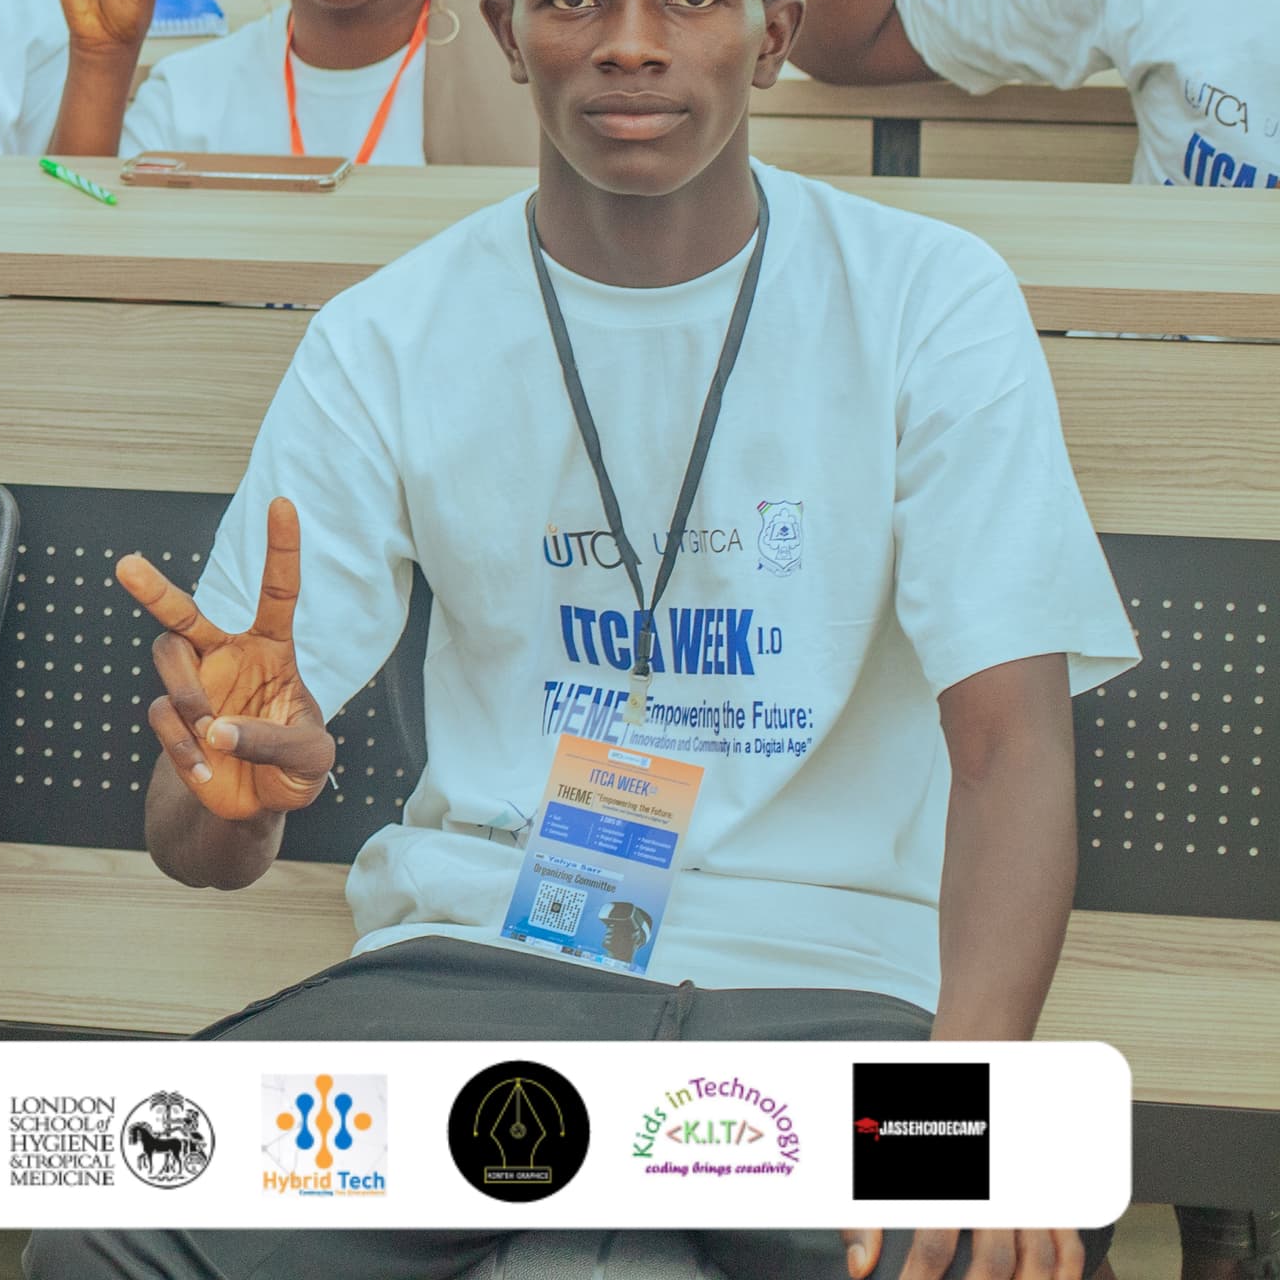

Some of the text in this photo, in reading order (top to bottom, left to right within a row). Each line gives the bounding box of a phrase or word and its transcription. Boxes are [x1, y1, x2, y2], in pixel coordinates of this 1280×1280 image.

[669, 607, 755, 675] WEEK
[542, 681, 630, 743] THEME
[722, 700, 746, 729] the
[752, 701, 813, 729] Future:
[630, 730, 676, 751] Innovation
[732, 738, 742, 753] in
[745, 742, 751, 754] a
[754, 738, 784, 758] Digital
[557, 784, 593, 806] THEME
[617, 773, 651, 797] WEEK
